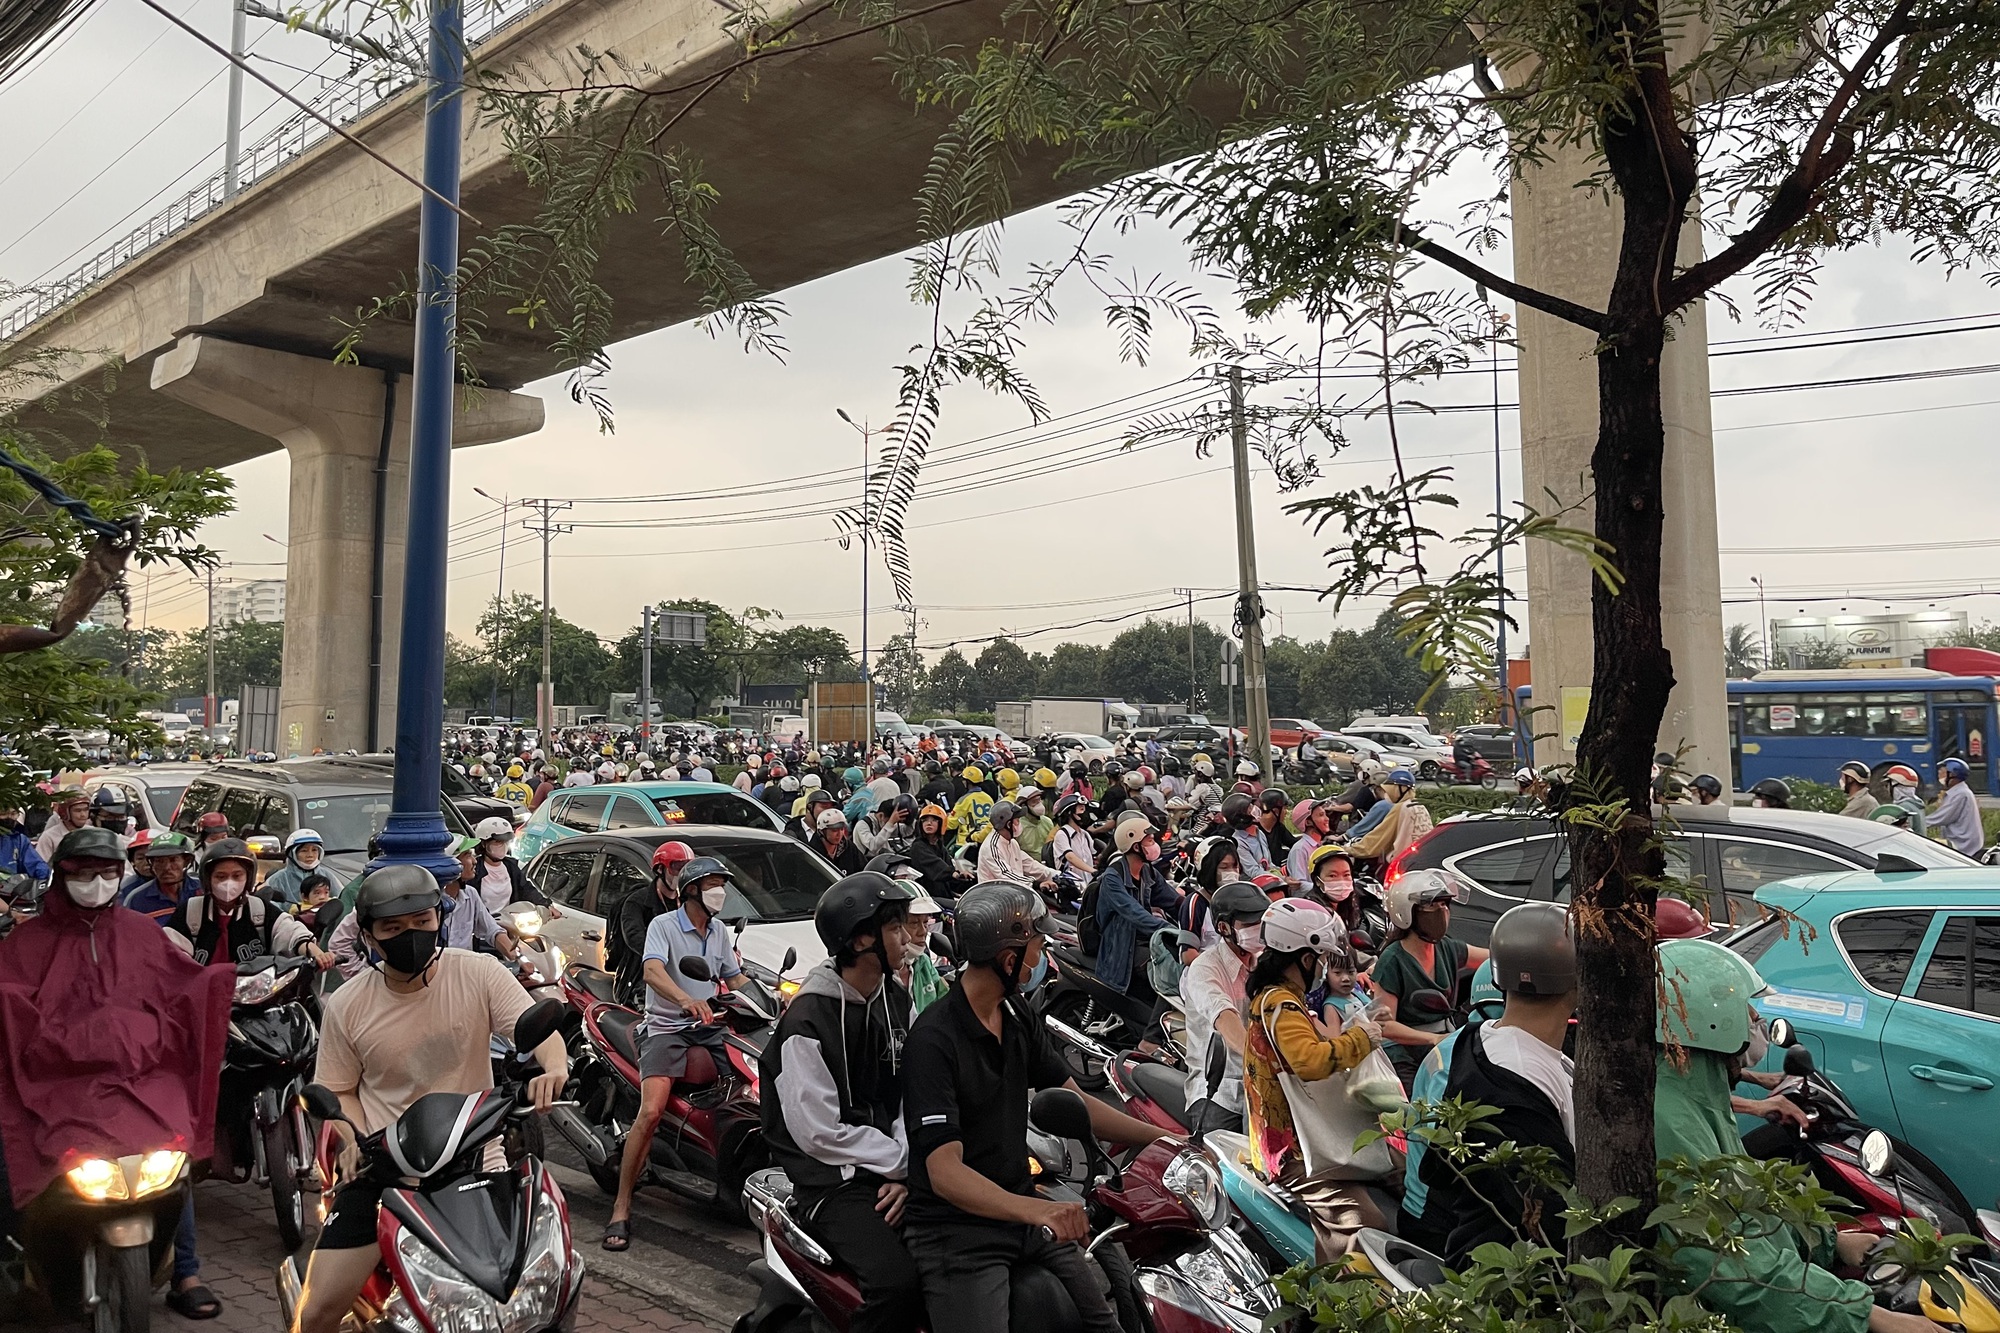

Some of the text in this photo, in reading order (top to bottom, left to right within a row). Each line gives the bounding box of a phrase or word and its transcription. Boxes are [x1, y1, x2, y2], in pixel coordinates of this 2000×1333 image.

[506, 787, 526, 801] be
[666, 811, 686, 820] TAXI
[972, 799, 991, 818] be
